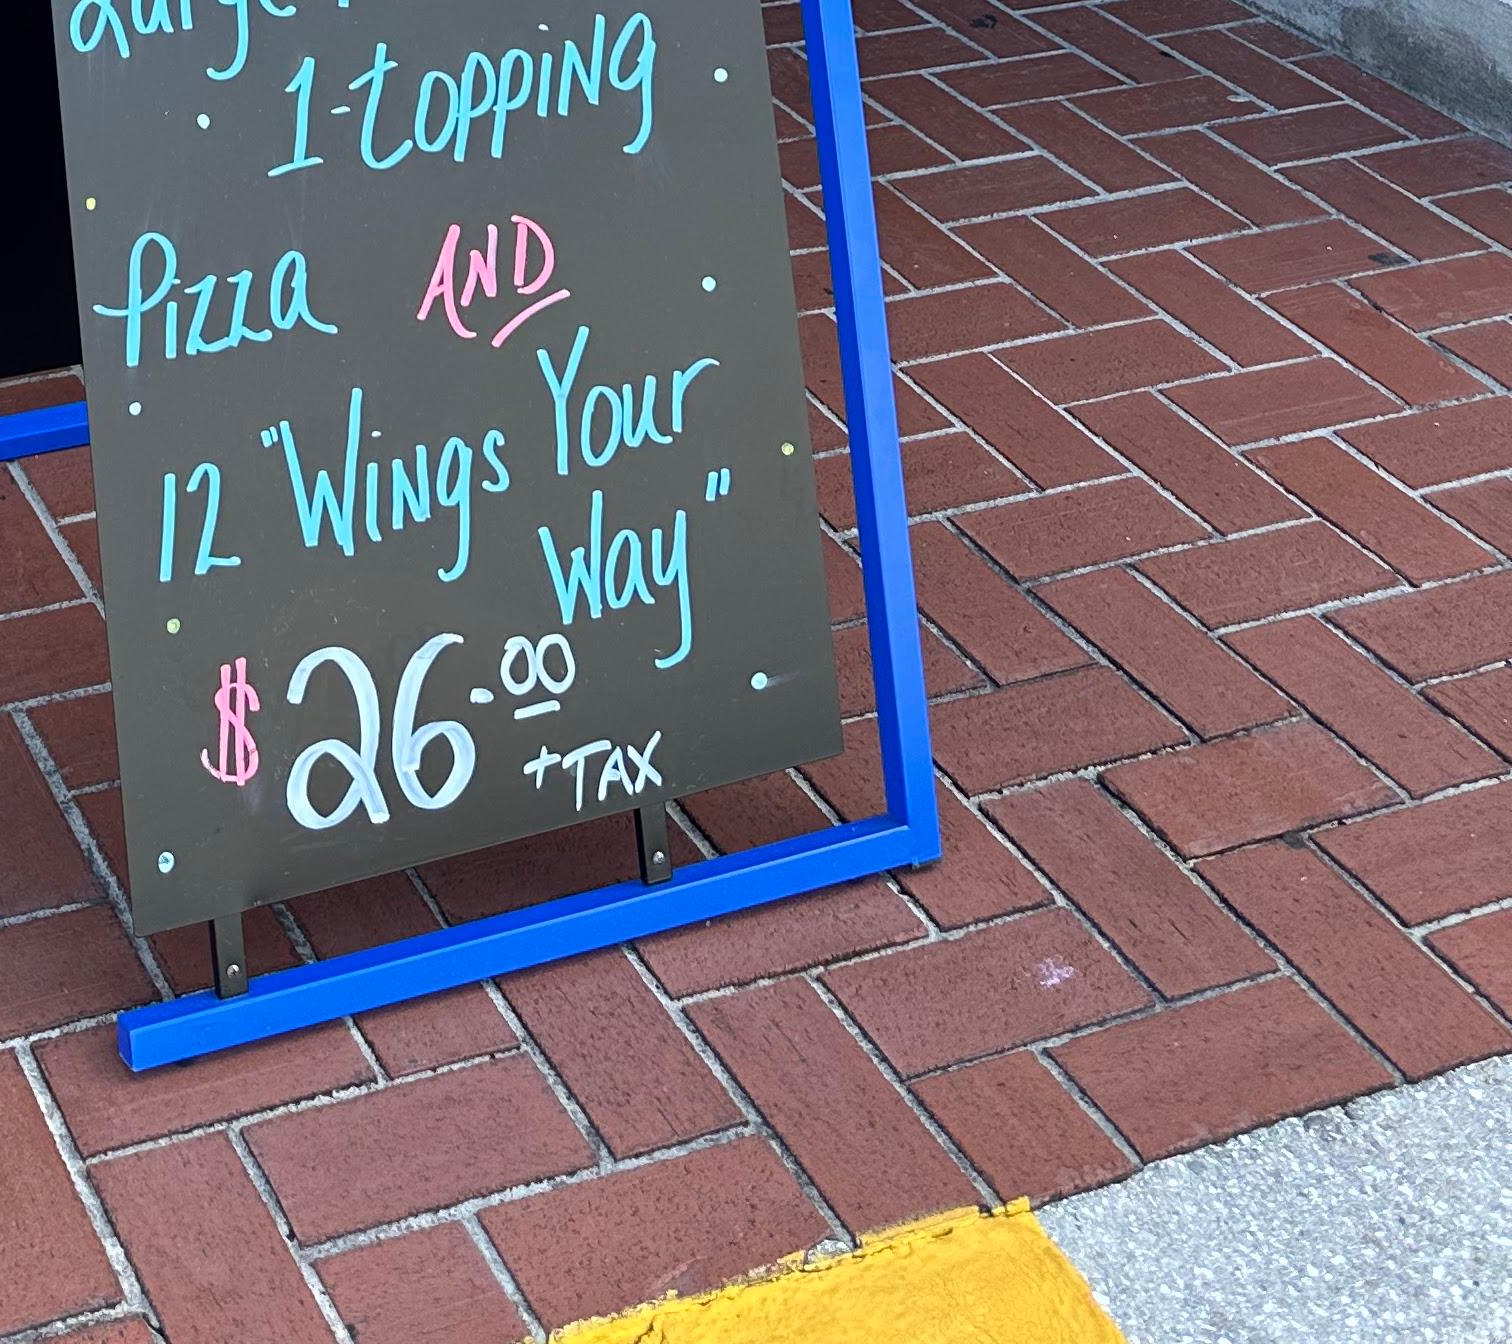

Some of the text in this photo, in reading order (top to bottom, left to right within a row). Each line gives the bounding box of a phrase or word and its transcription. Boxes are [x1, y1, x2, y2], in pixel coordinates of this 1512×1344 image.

[92, 215, 558, 368] Pizza AND
[158, 462, 242, 583] 12
[536, 325, 720, 476] Your
